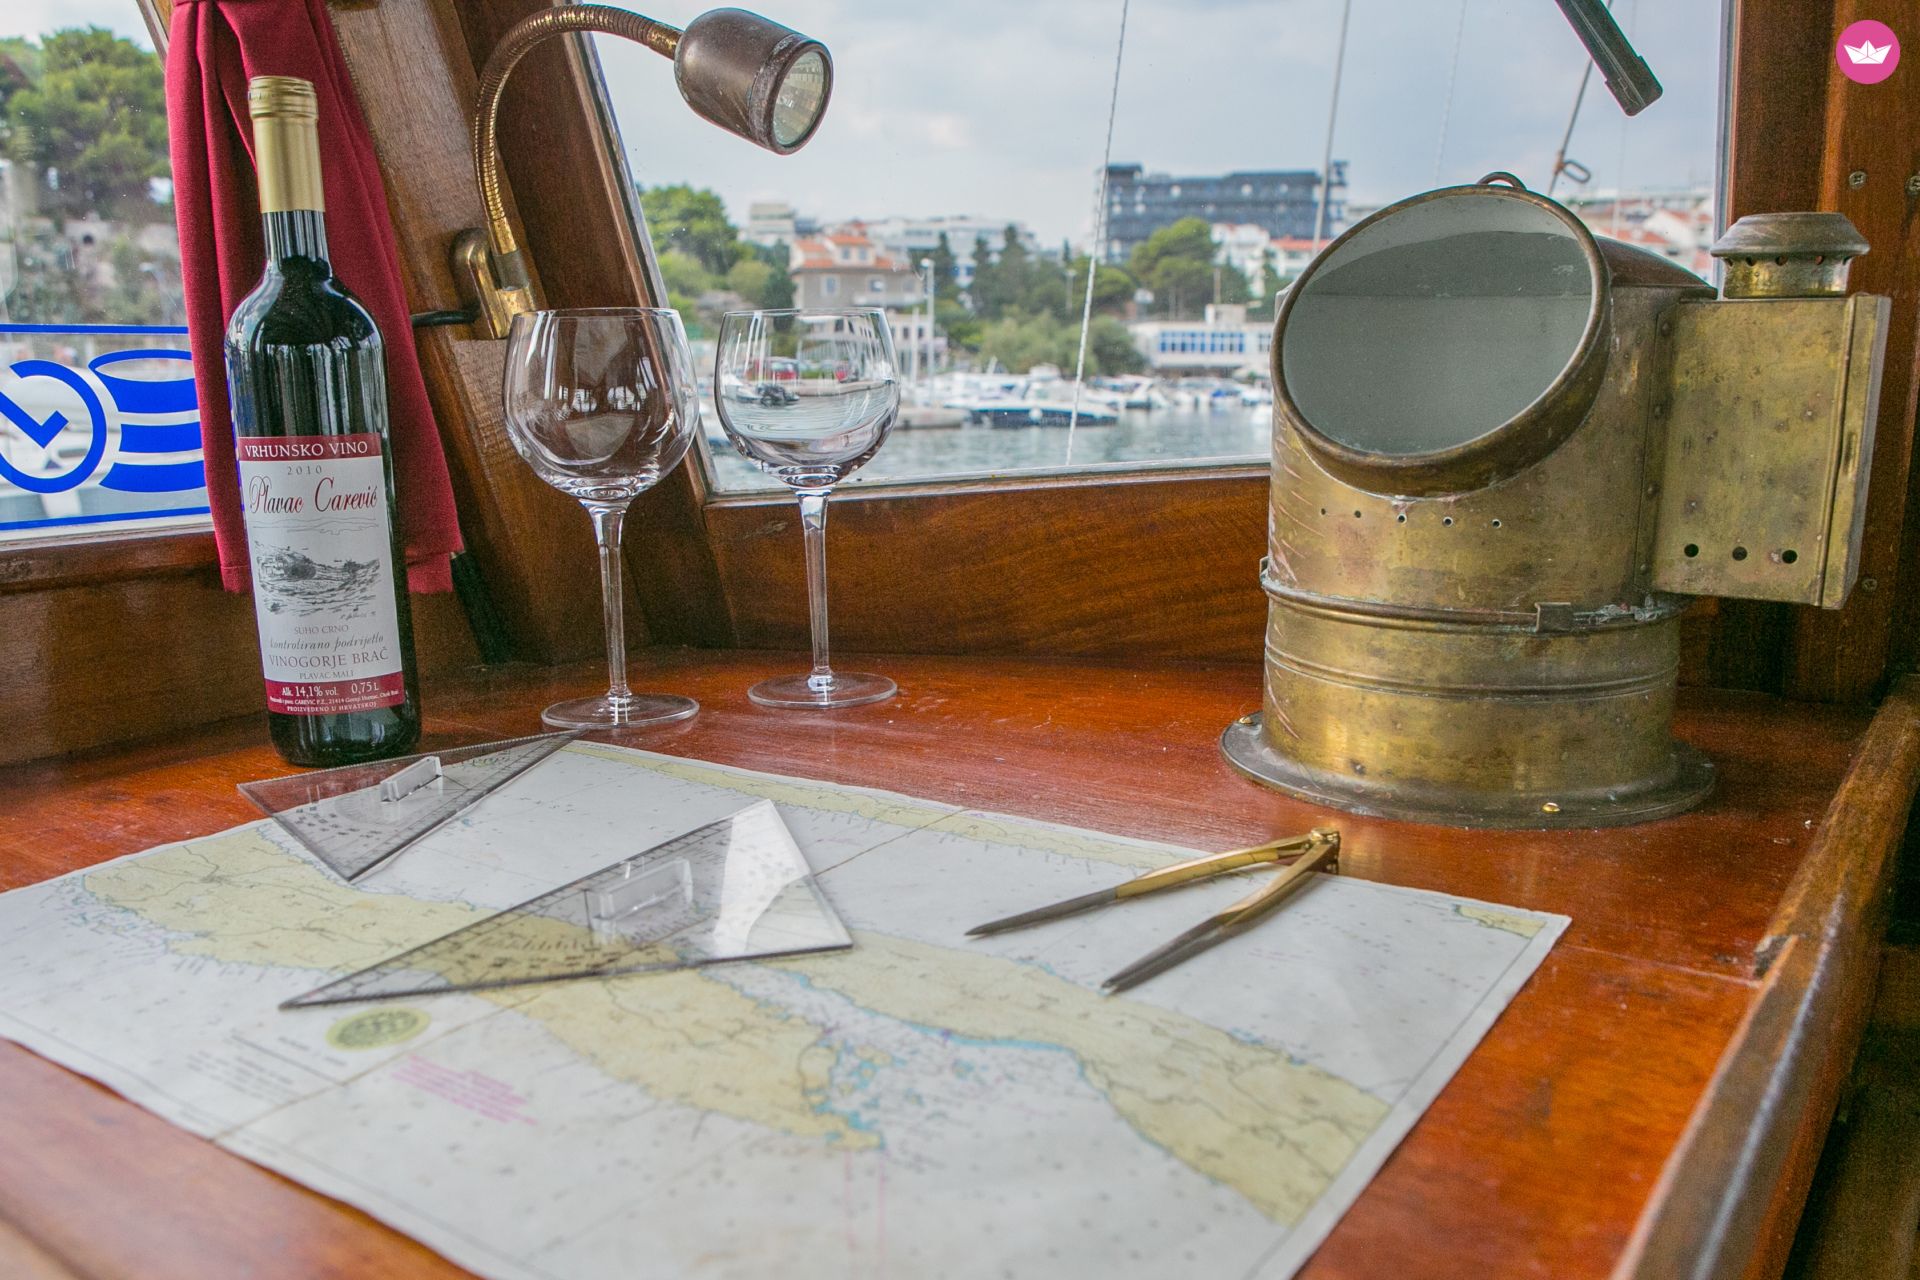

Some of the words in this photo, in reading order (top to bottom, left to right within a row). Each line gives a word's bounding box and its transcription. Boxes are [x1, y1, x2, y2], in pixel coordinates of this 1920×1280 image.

[245, 443, 324, 458] VRHUNSKO
[329, 441, 368, 454] VINO
[287, 465, 322, 476] 2010
[249, 476, 304, 514] Plavac
[315, 477, 378, 512] Carević
[294, 626, 320, 635] SUHO
[321, 624, 349, 634] CRNO
[334, 631, 384, 652] podrijetlo
[269, 654, 348, 669] VINOGORJE
[352, 646, 389, 664] BRAČ
[295, 685, 323, 699] 14,1%
